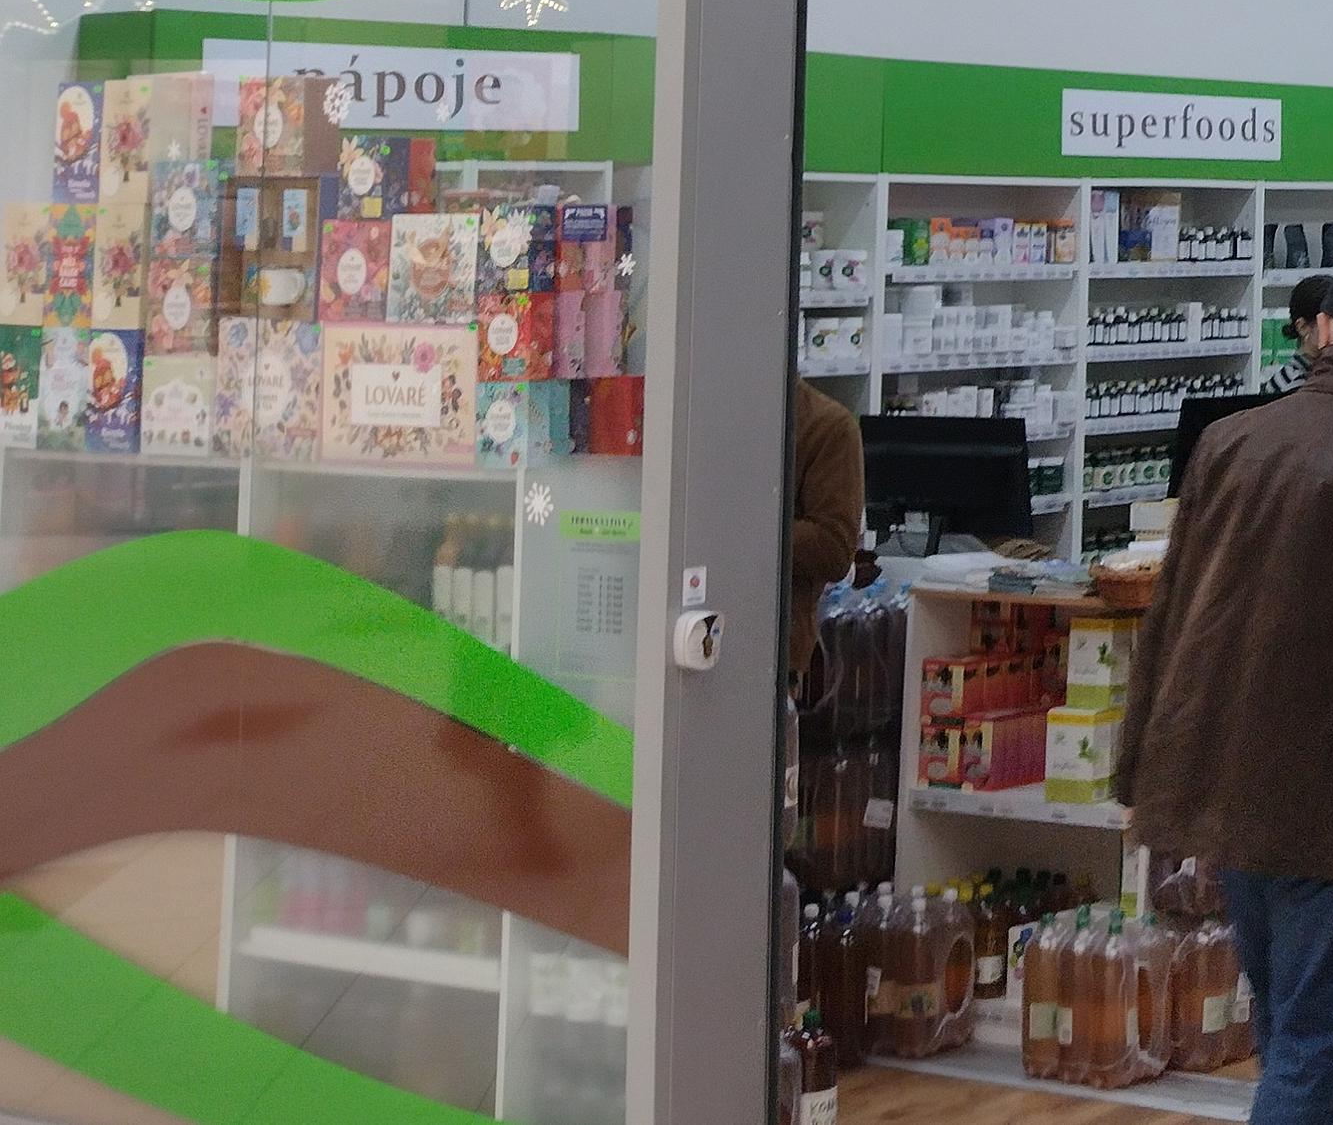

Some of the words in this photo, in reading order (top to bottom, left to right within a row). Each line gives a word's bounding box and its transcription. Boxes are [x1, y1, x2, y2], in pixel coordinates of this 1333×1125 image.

[293, 54, 503, 117] ápoje
[1069, 103, 1276, 148] superfoods
[365, 381, 427, 408] LOVARÉ
